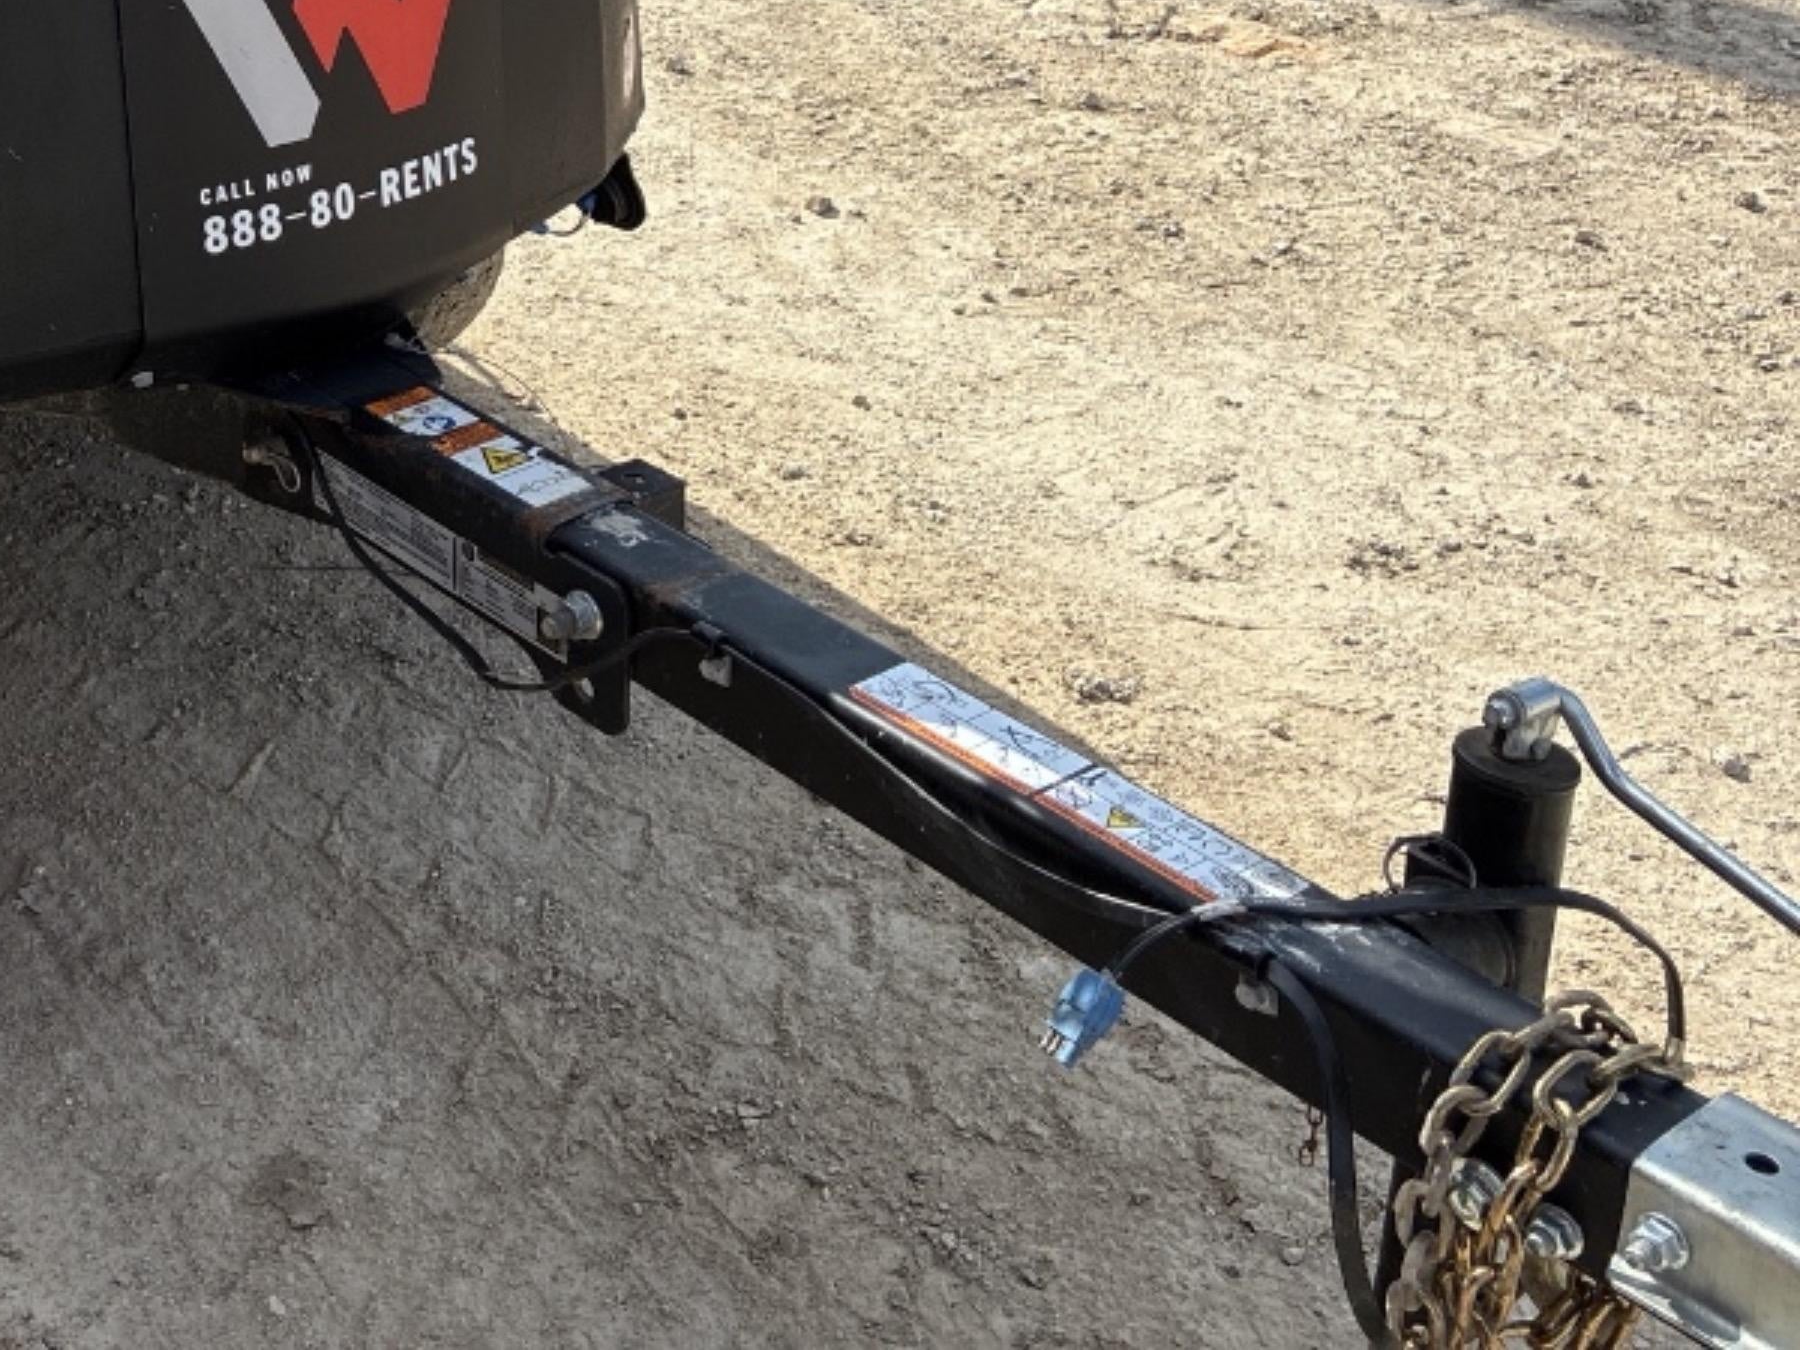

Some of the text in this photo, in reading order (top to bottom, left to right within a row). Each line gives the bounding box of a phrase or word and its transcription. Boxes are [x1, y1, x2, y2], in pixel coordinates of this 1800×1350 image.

[199, 163, 314, 206] CALL NOW
[203, 137, 478, 255] 888-80-RENTS
